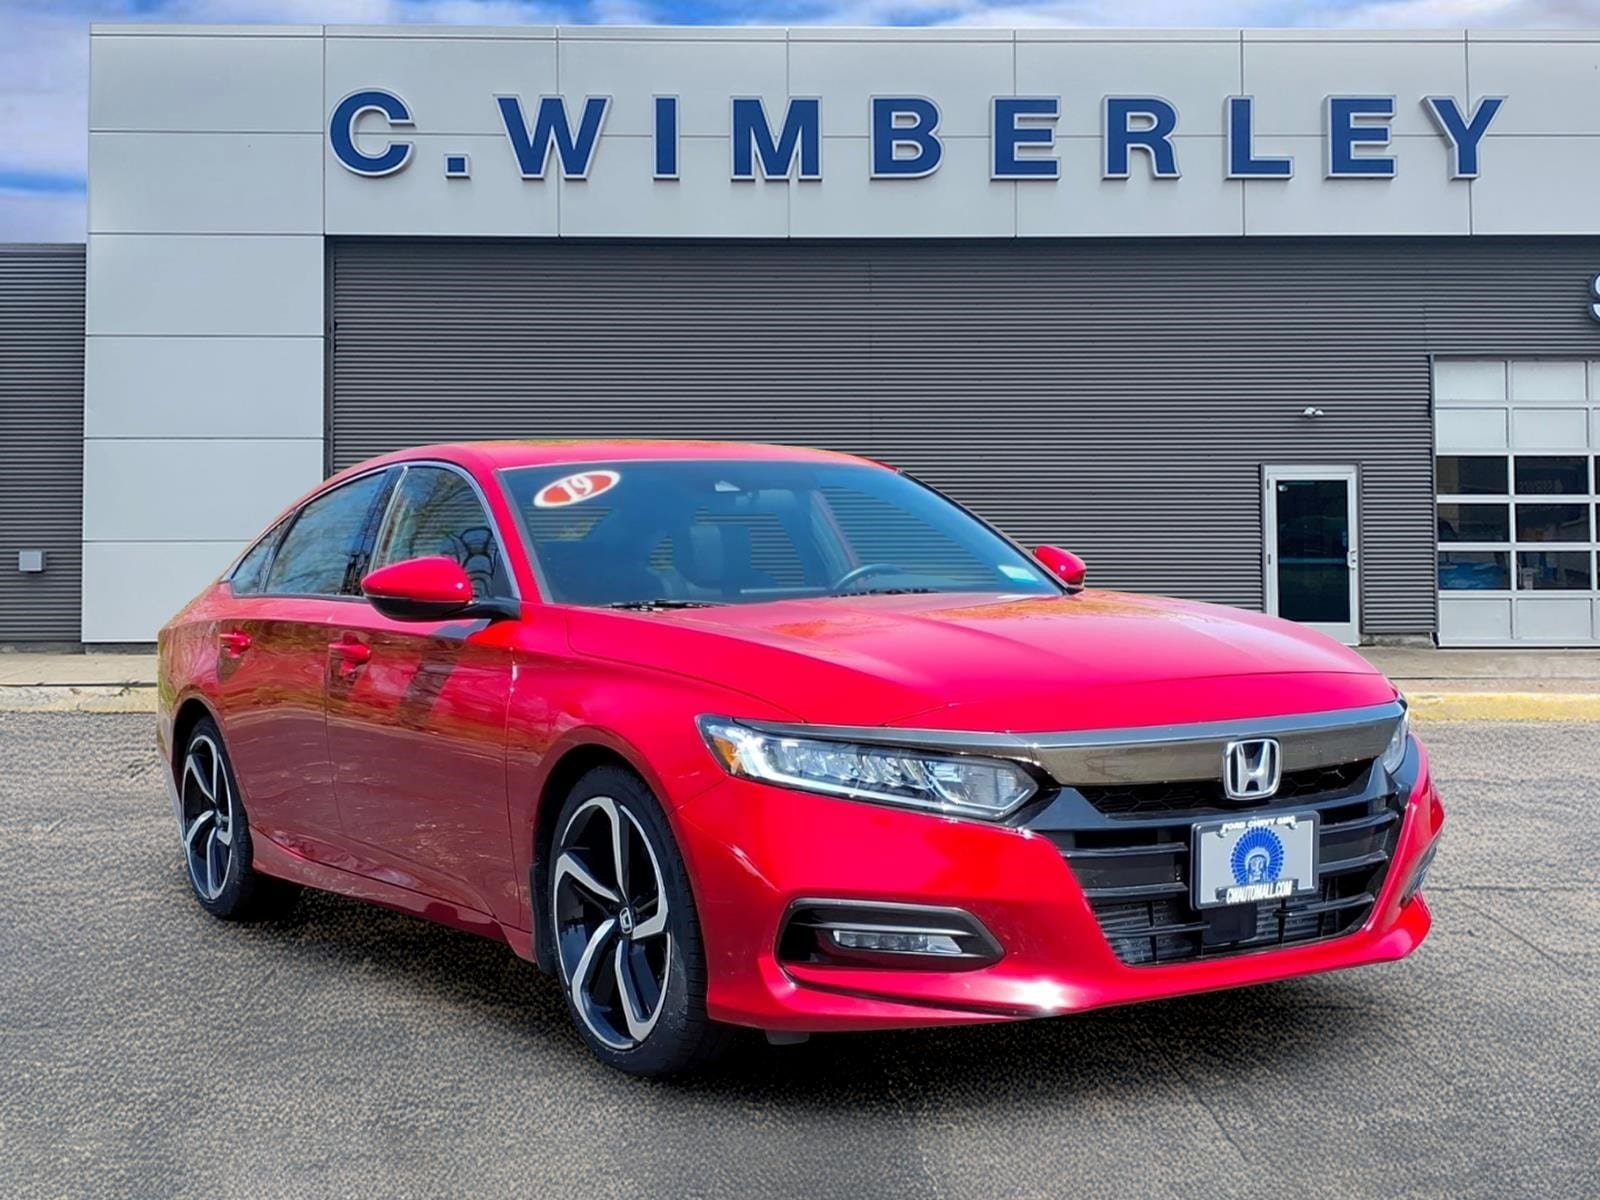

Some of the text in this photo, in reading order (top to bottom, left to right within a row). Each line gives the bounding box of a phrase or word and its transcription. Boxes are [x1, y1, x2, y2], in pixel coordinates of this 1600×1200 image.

[329, 87, 1508, 182] C. WIMBERLEY
[560, 475, 593, 501] 19
